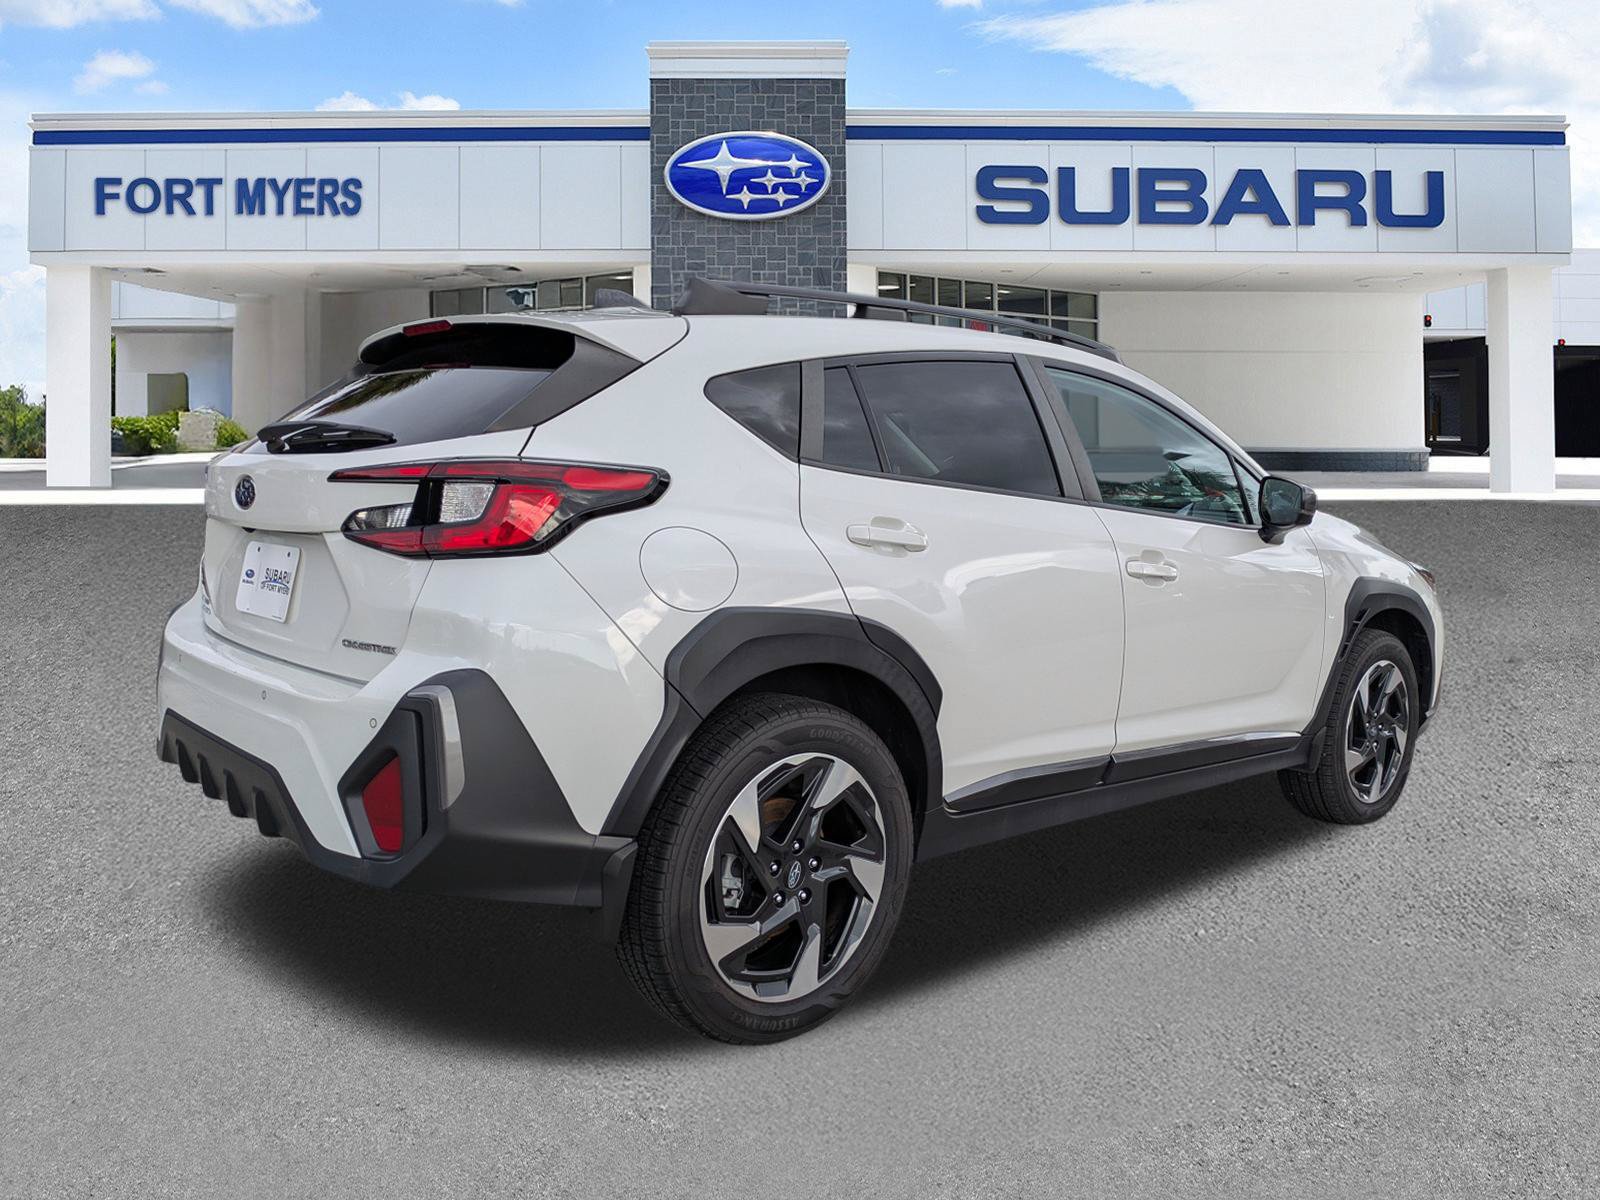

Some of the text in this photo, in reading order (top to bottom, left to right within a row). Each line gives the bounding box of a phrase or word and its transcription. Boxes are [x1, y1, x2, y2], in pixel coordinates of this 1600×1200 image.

[95, 177, 362, 216] FORT MYERS
[975, 165, 1445, 228] SUBARU
[265, 567, 291, 584] SUBARU
